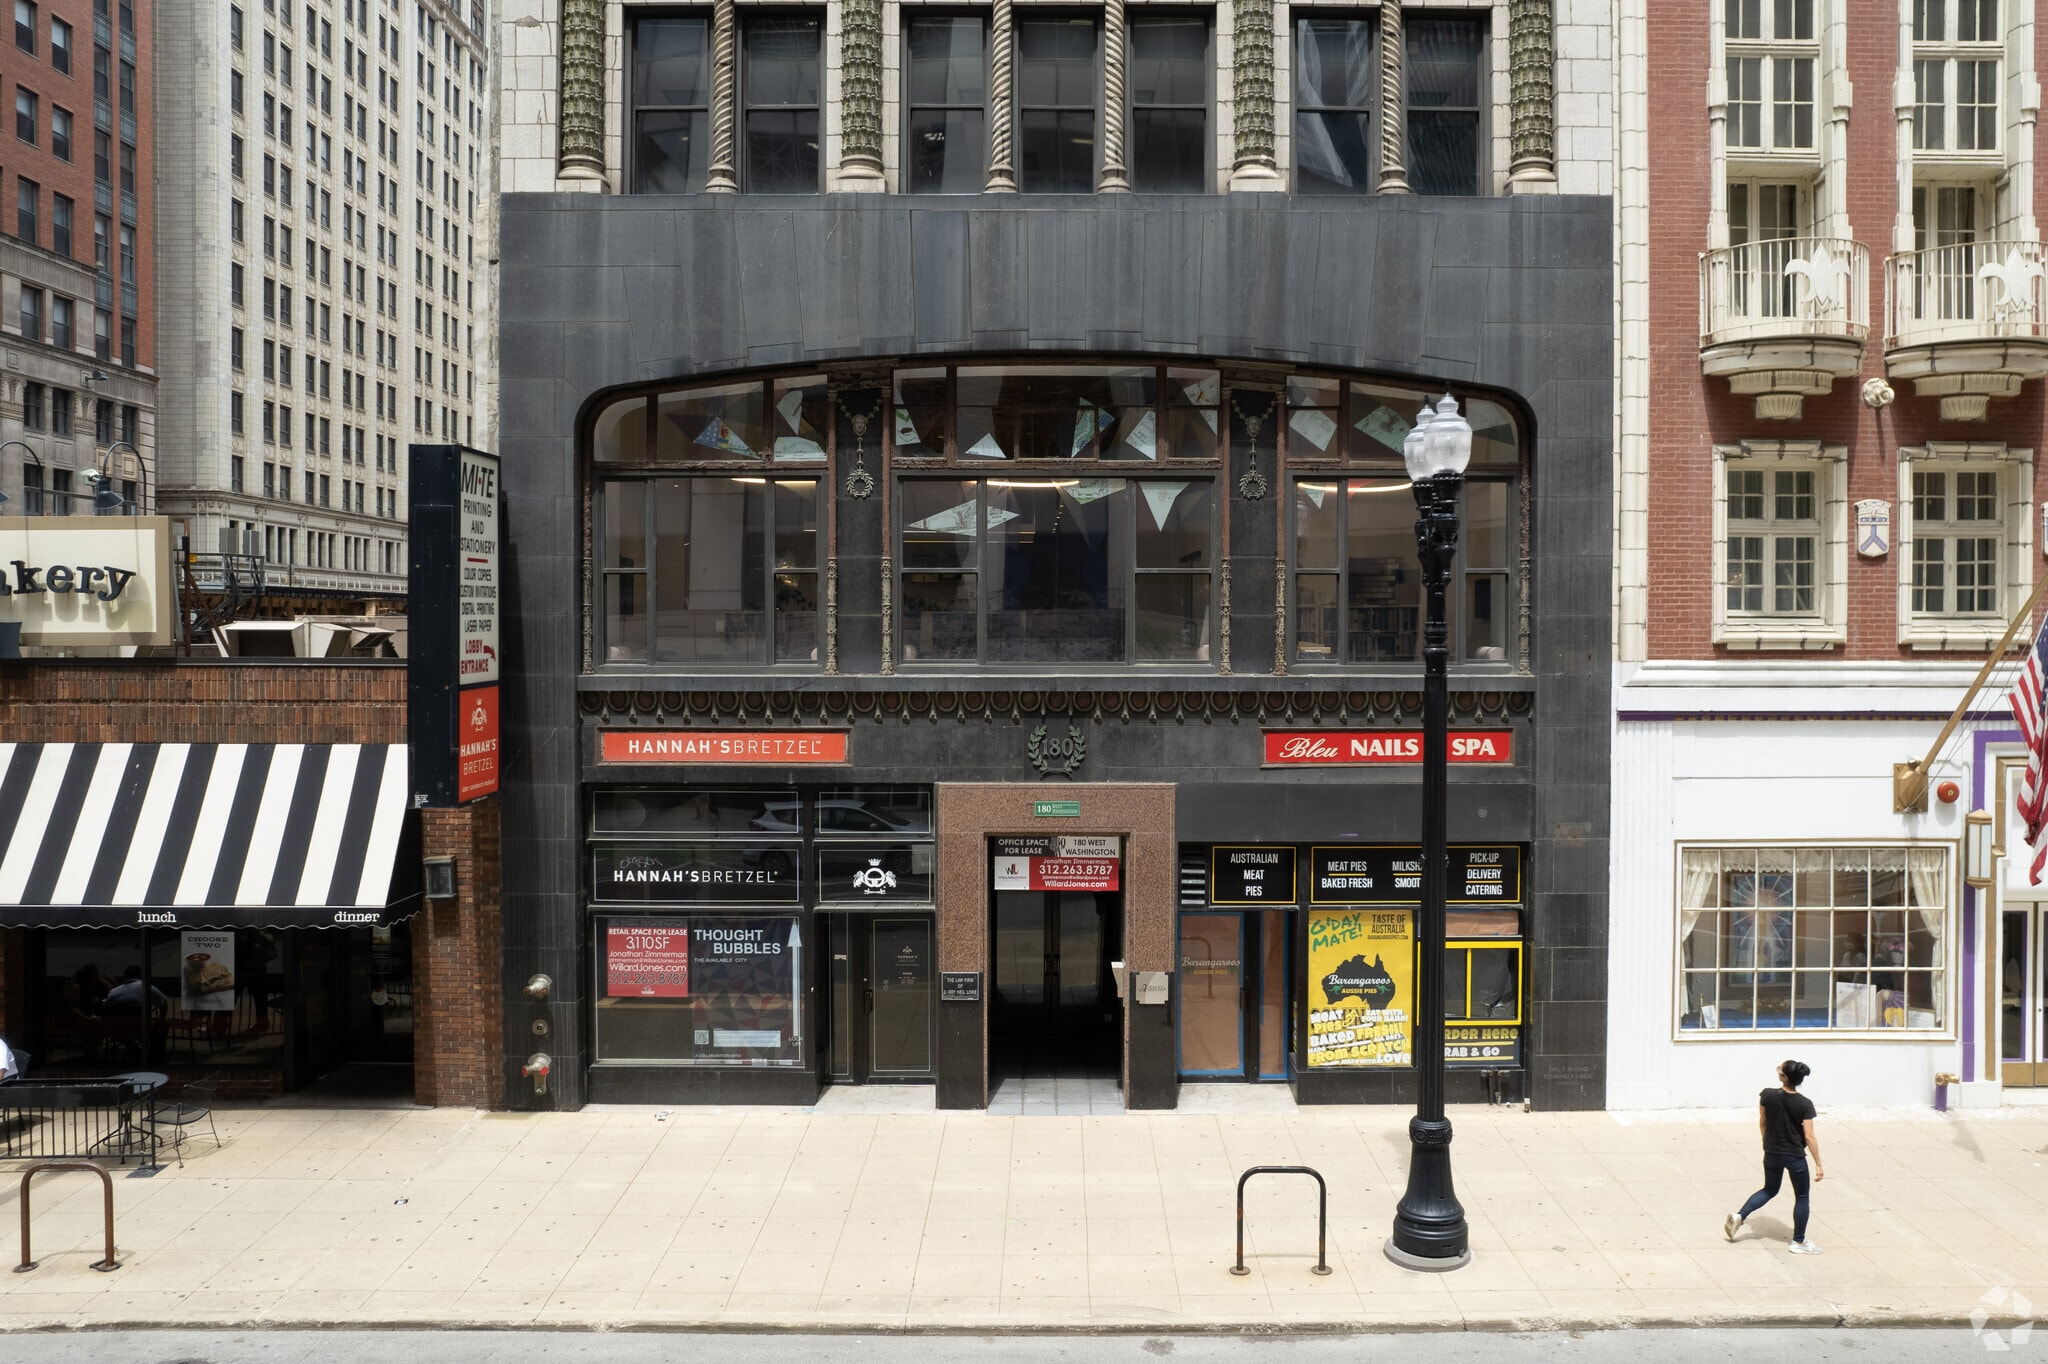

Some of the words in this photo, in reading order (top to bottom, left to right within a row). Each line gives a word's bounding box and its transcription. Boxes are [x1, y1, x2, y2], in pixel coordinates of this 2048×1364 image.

[464, 499, 492, 518] PRINTING
[471, 520, 485, 535] AND
[460, 537, 496, 555] STATIONERY
[464, 567, 476, 580] COLOR
[477, 568, 492, 582] COPIES
[477, 602, 495, 615] PRINTING
[464, 620, 477, 633] LASER
[479, 619, 492, 632] PAPER
[465, 639, 483, 654] LOBBY
[461, 659, 489, 675] ENTRANCE
[461, 738, 497, 757] HANNAH'S
[1042, 738, 1074, 756] 180
[1279, 737, 1338, 758] Bleu
[1351, 739, 1419, 756] NAILS
[1451, 738, 1497, 756] SPA
[463, 757, 494, 776] BRETZEL
[1037, 805, 1051, 813] 180
[1065, 848, 1116, 856] WASHINGTON
[1469, 853, 1500, 863] PICK-UP
[1230, 853, 1279, 864] AUSTRALIAN
[1039, 865, 1113, 874] 312.263.8787
[1328, 861, 1349, 872] MEAT
[1350, 861, 1367, 872] PIES
[1392, 861, 1422, 872] MILKSH
[1243, 869, 1265, 880] MEAT
[1467, 868, 1502, 879] DELIVERY
[1045, 880, 1107, 888] WillardJones.com
[1321, 878, 1347, 888] BAKED
[1349, 878, 1373, 888] FRESH
[1395, 878, 1421, 888] SMOOT
[1245, 886, 1263, 896] PIES
[1466, 884, 1503, 896] CATERING
[137, 911, 177, 923] lunch
[334, 911, 380, 923] dinner
[1372, 914, 1395, 924] TASTE
[1396, 914, 1406, 924] OF
[1310, 912, 1362, 936] G'DAY
[1371, 924, 1406, 934] AUSTRALIA
[631, 928, 652, 936] SPACE
[693, 929, 764, 941] THOUGHT
[1312, 923, 1363, 953] MATE!
[713, 942, 781, 954] BUBBLES
[609, 963, 687, 972] WillardJones.com
[1181, 956, 1241, 969] Barangaroos
[609, 972, 687, 985] 312.263.8787
[1328, 974, 1391, 987] Barangaroos
[1445, 1046, 1468, 1057] RAB
[1470, 1047, 1480, 1057] &
[1482, 1046, 1500, 1057] GO
